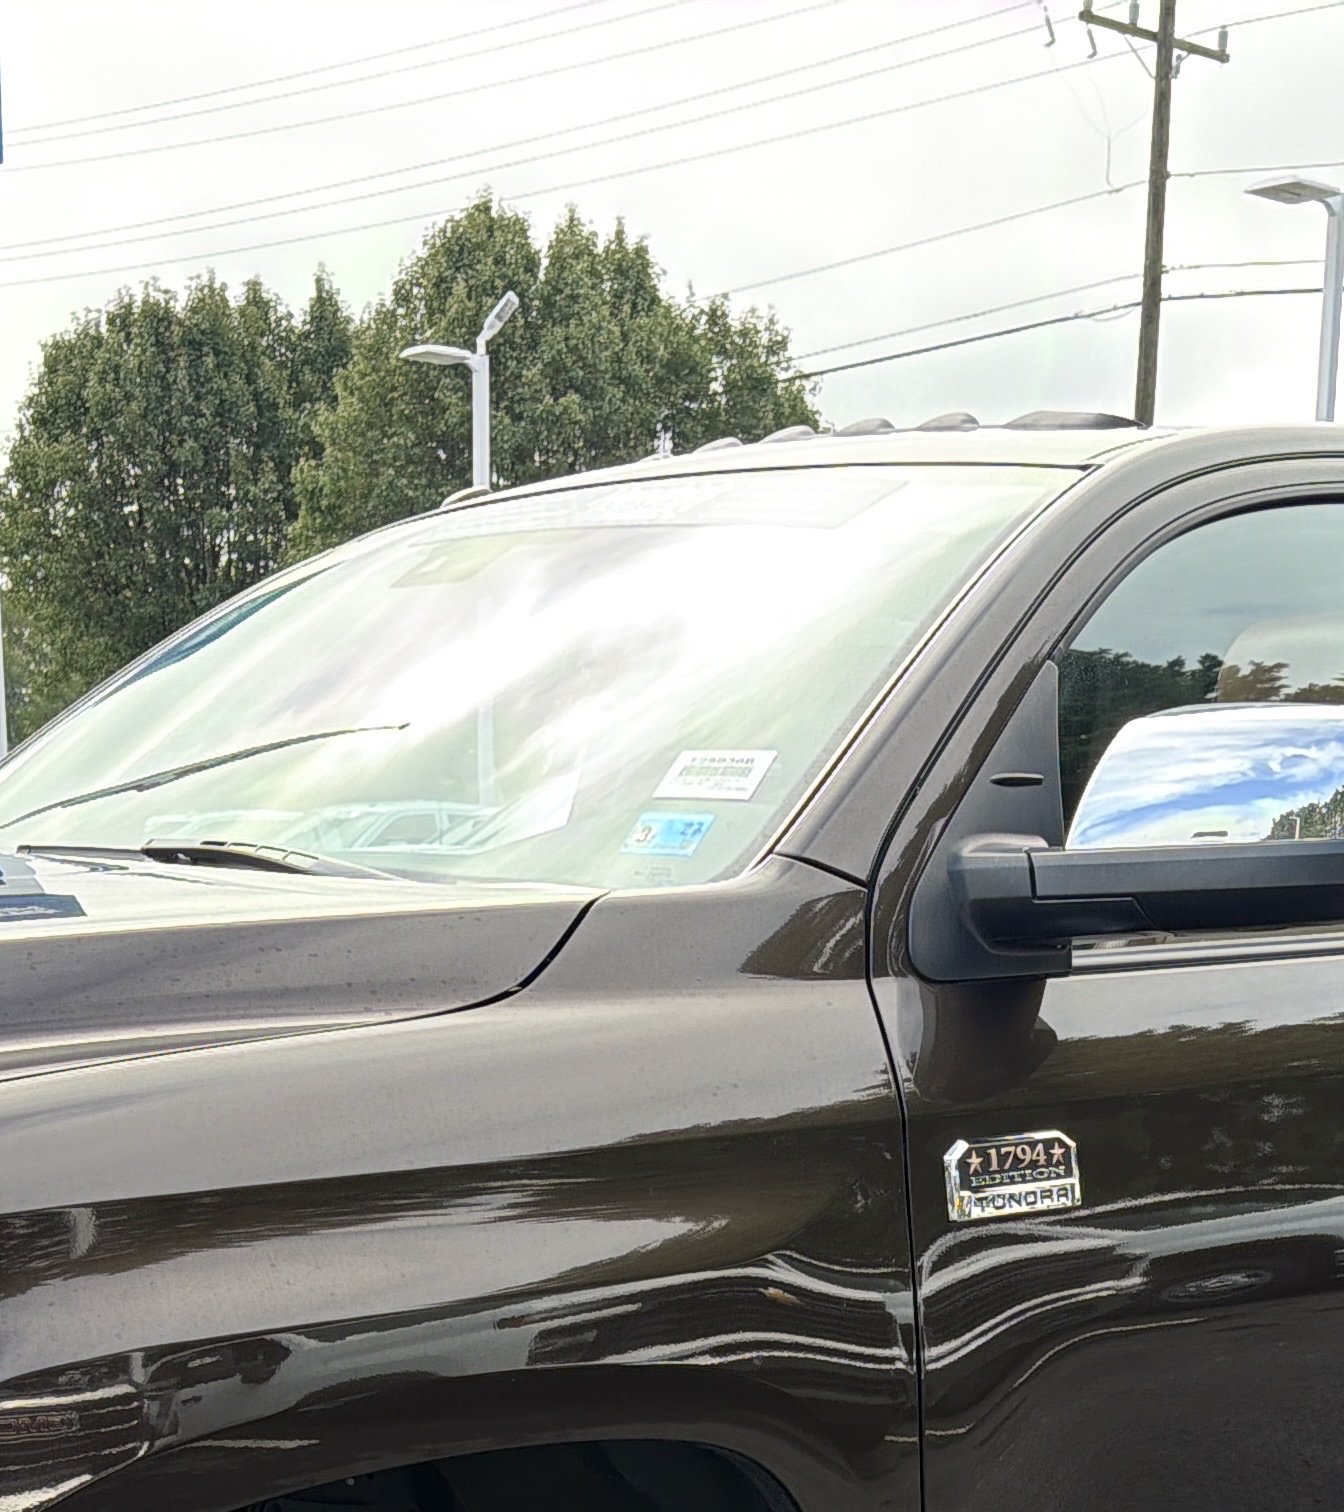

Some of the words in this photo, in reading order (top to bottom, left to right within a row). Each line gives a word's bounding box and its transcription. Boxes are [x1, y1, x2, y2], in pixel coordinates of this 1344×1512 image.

[987, 1143, 1047, 1171] 1794
[970, 1166, 1066, 1187] EDITION
[974, 1187, 1070, 1212] TUNDRA
